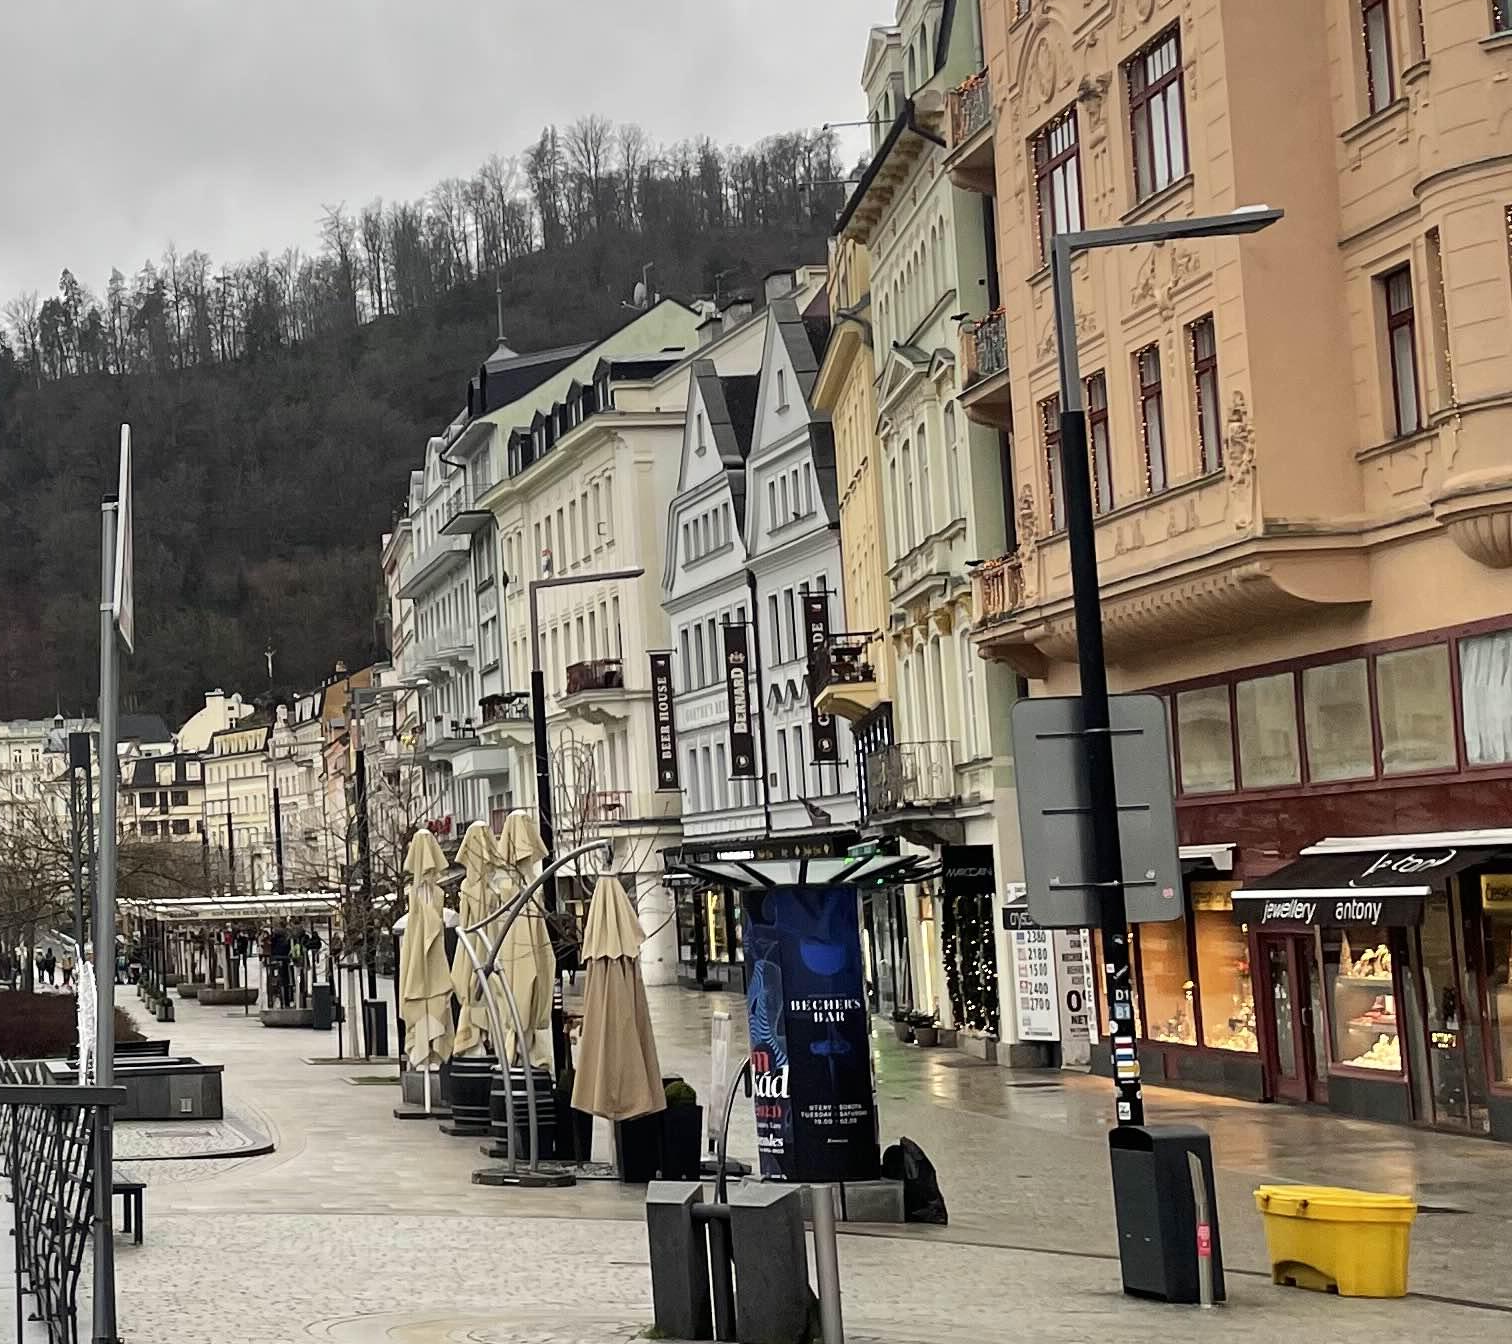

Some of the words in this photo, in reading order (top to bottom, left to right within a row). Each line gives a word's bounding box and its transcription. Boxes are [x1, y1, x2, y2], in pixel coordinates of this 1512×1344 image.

[656, 676, 670, 722] HOUSE
[730, 667, 748, 734] BERNARD
[661, 725, 672, 760] BEER
[1261, 899, 1316, 925] jewellery
[1335, 899, 1382, 925] antony
[1028, 948, 1048, 960] 2180
[1115, 989, 1129, 1001] D1
[814, 1011, 845, 1023] BAR
